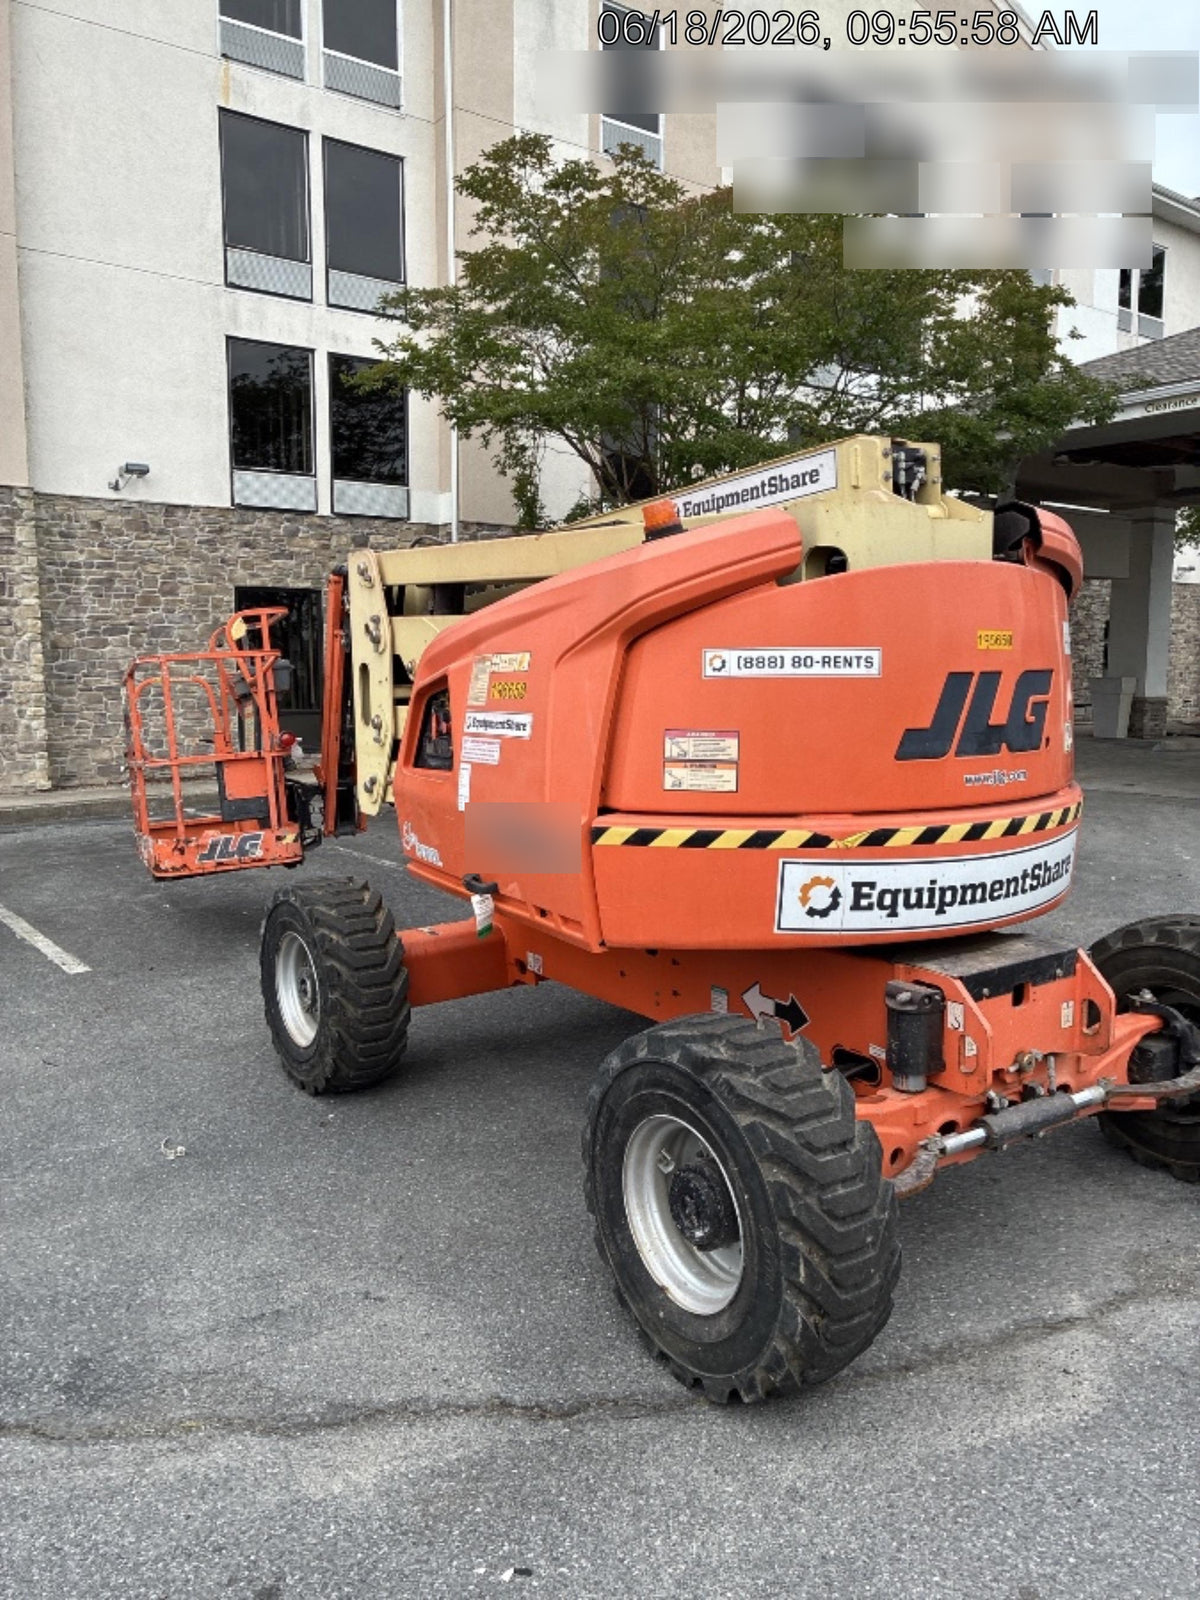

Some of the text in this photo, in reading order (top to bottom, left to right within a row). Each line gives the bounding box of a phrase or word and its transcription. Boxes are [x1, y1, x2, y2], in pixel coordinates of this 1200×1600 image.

[1145, 397, 1198, 413] Clearance
[683, 466, 821, 517] EquipmentShare
[791, 655, 875, 669] 80-RENTS
[893, 669, 1053, 761] JLG
[963, 769, 1028, 787] www.jlg.com
[197, 832, 263, 864] JLG
[849, 853, 1072, 919] EquipmentShare
